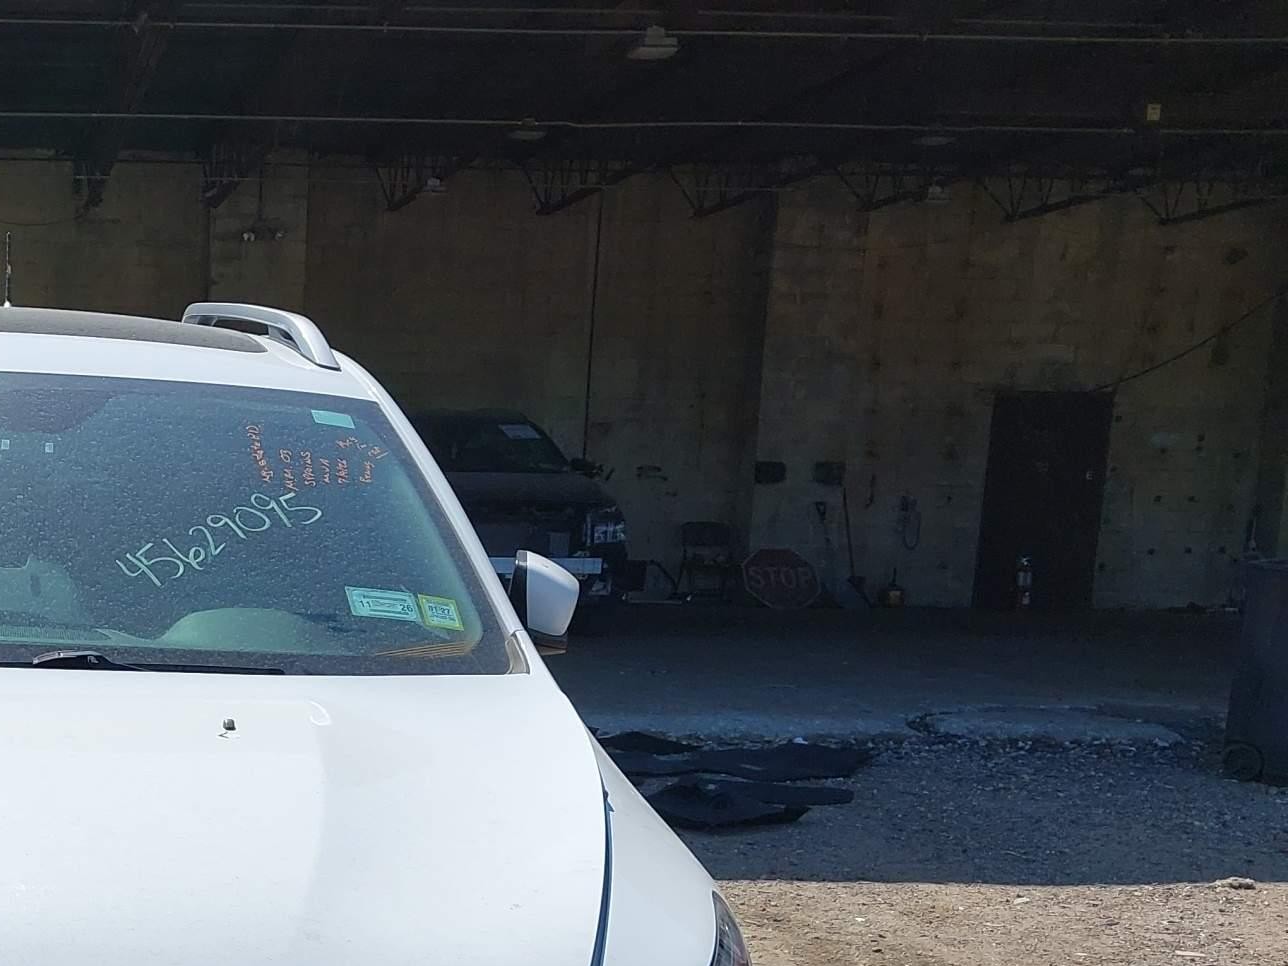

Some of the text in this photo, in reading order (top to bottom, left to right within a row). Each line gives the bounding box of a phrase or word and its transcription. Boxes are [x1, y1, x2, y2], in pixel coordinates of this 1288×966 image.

[116, 492, 322, 587] 45629095
[748, 566, 810, 588] STOP
[400, 603, 413, 613] 26
